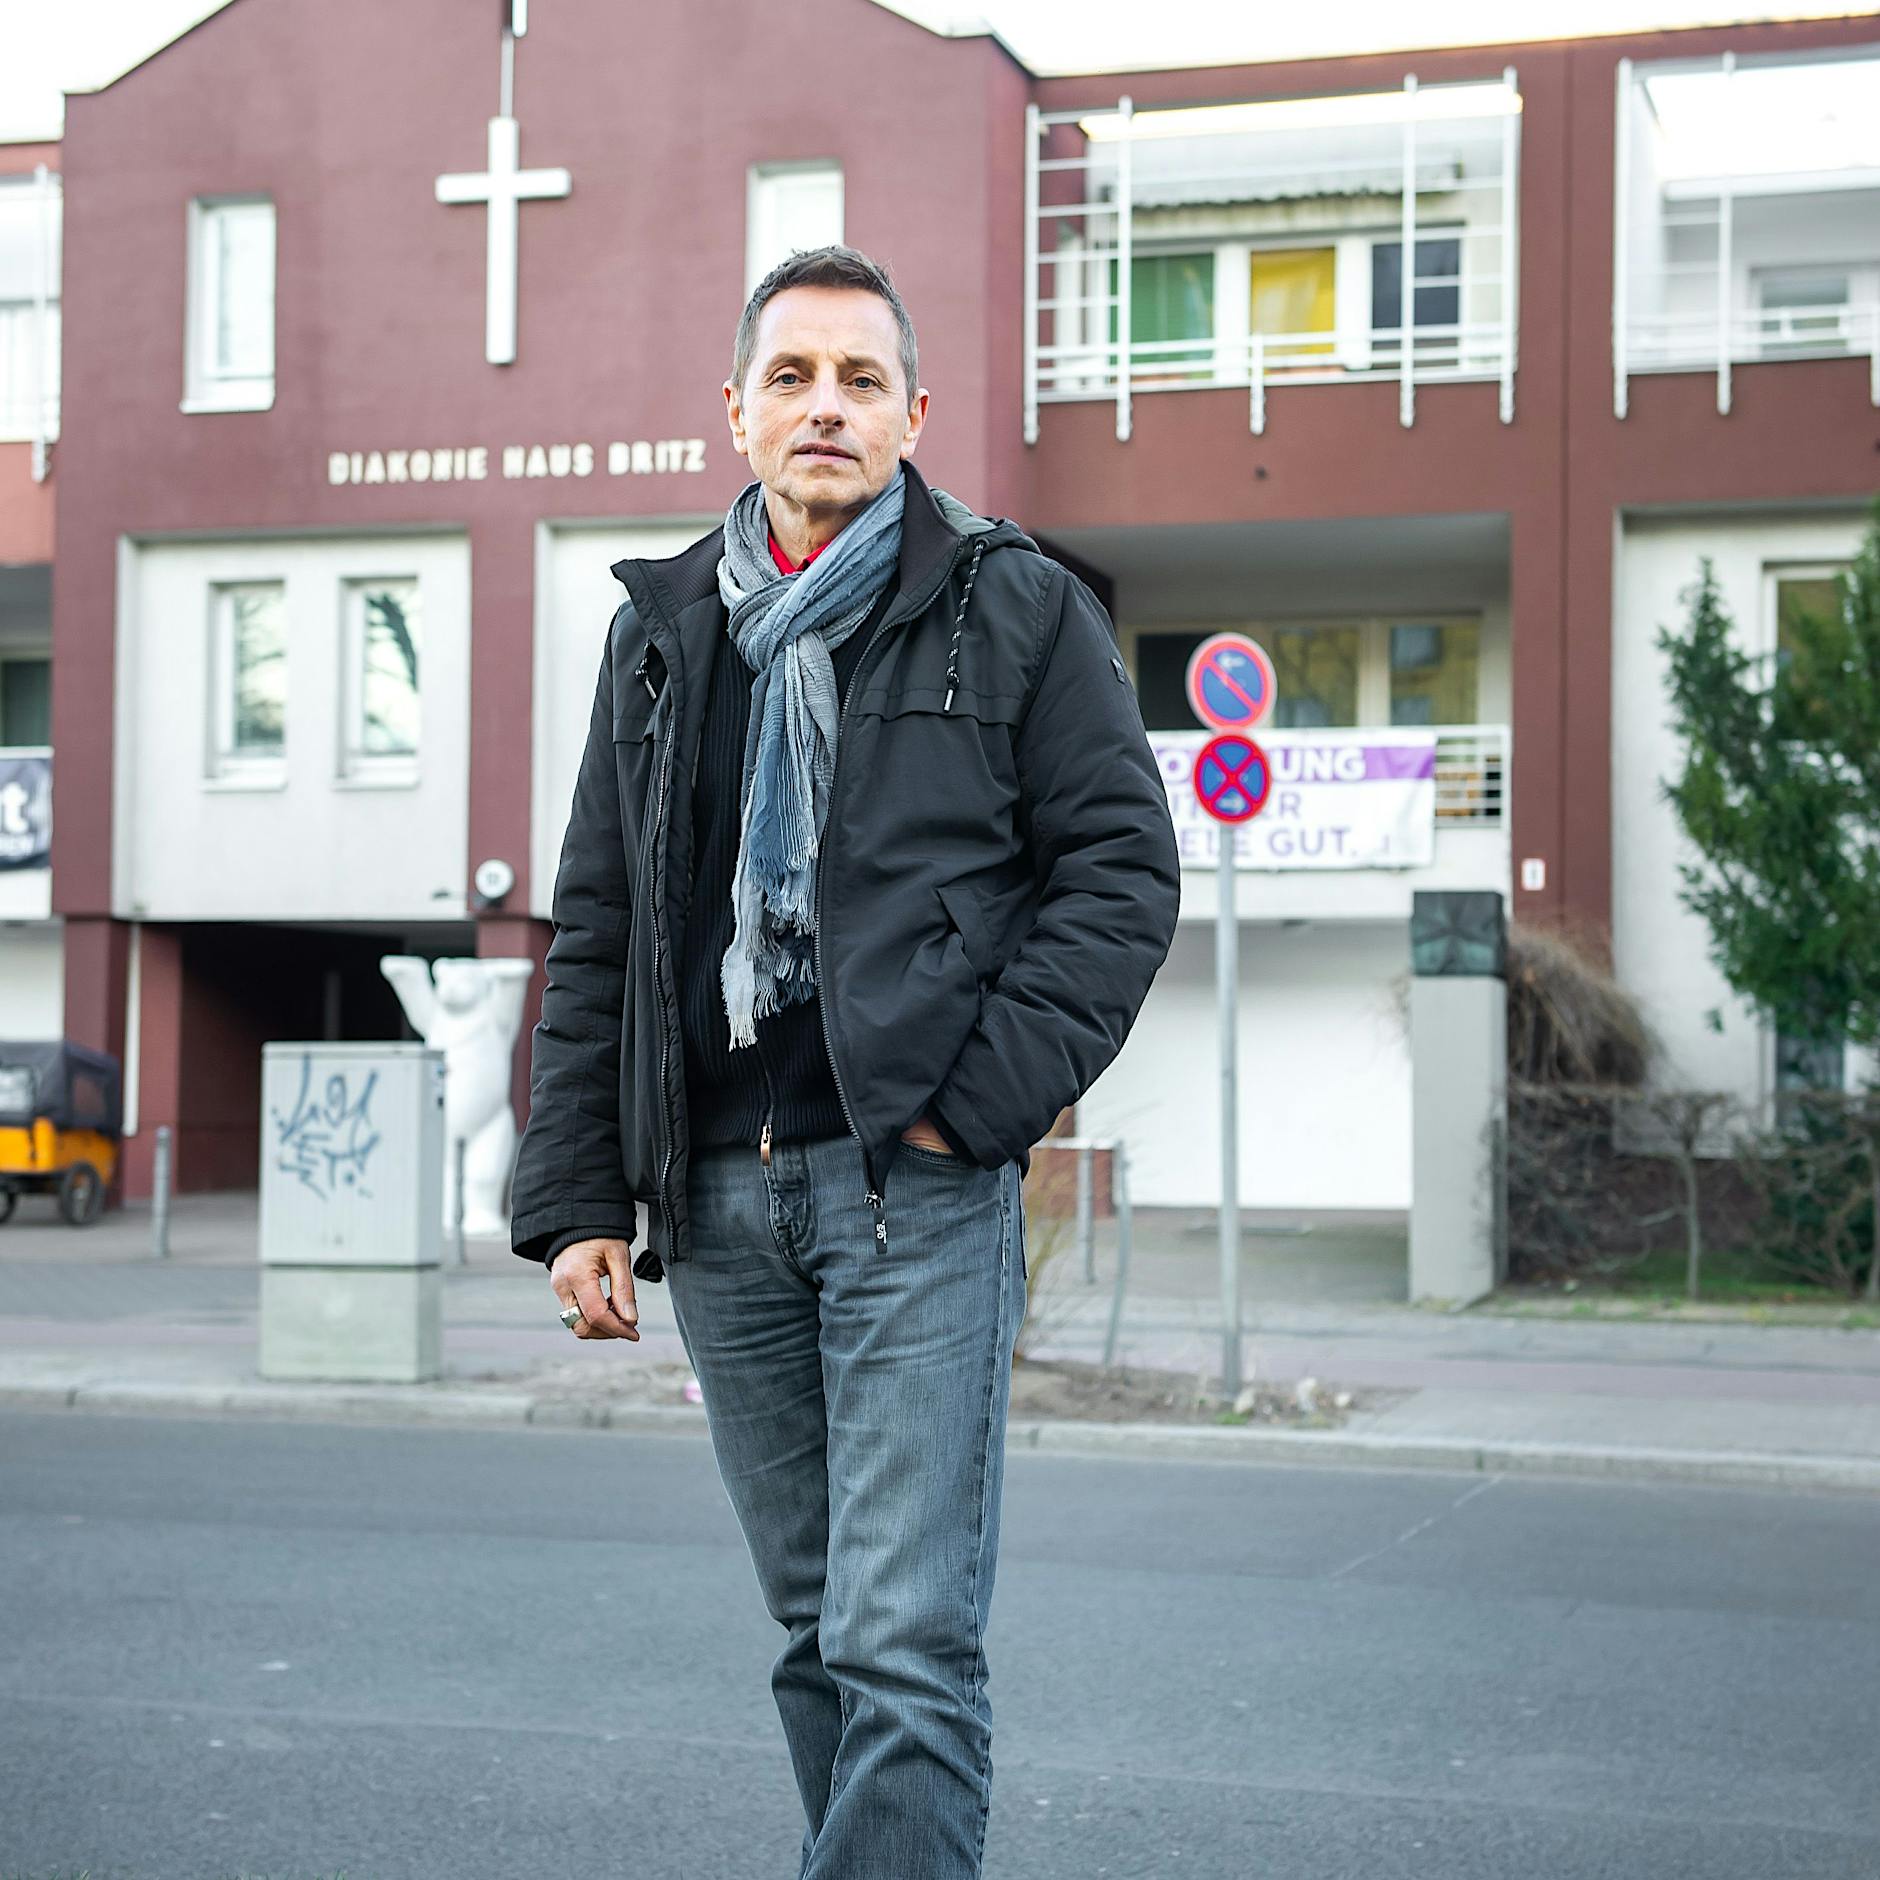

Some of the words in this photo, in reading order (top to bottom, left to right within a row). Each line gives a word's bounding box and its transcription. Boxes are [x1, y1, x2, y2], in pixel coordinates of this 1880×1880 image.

[328, 446, 488, 485] DIAKONIE
[502, 443, 595, 479] HAUS
[608, 438, 707, 475] BRITZ
[1267, 826, 1358, 858] GUT.
